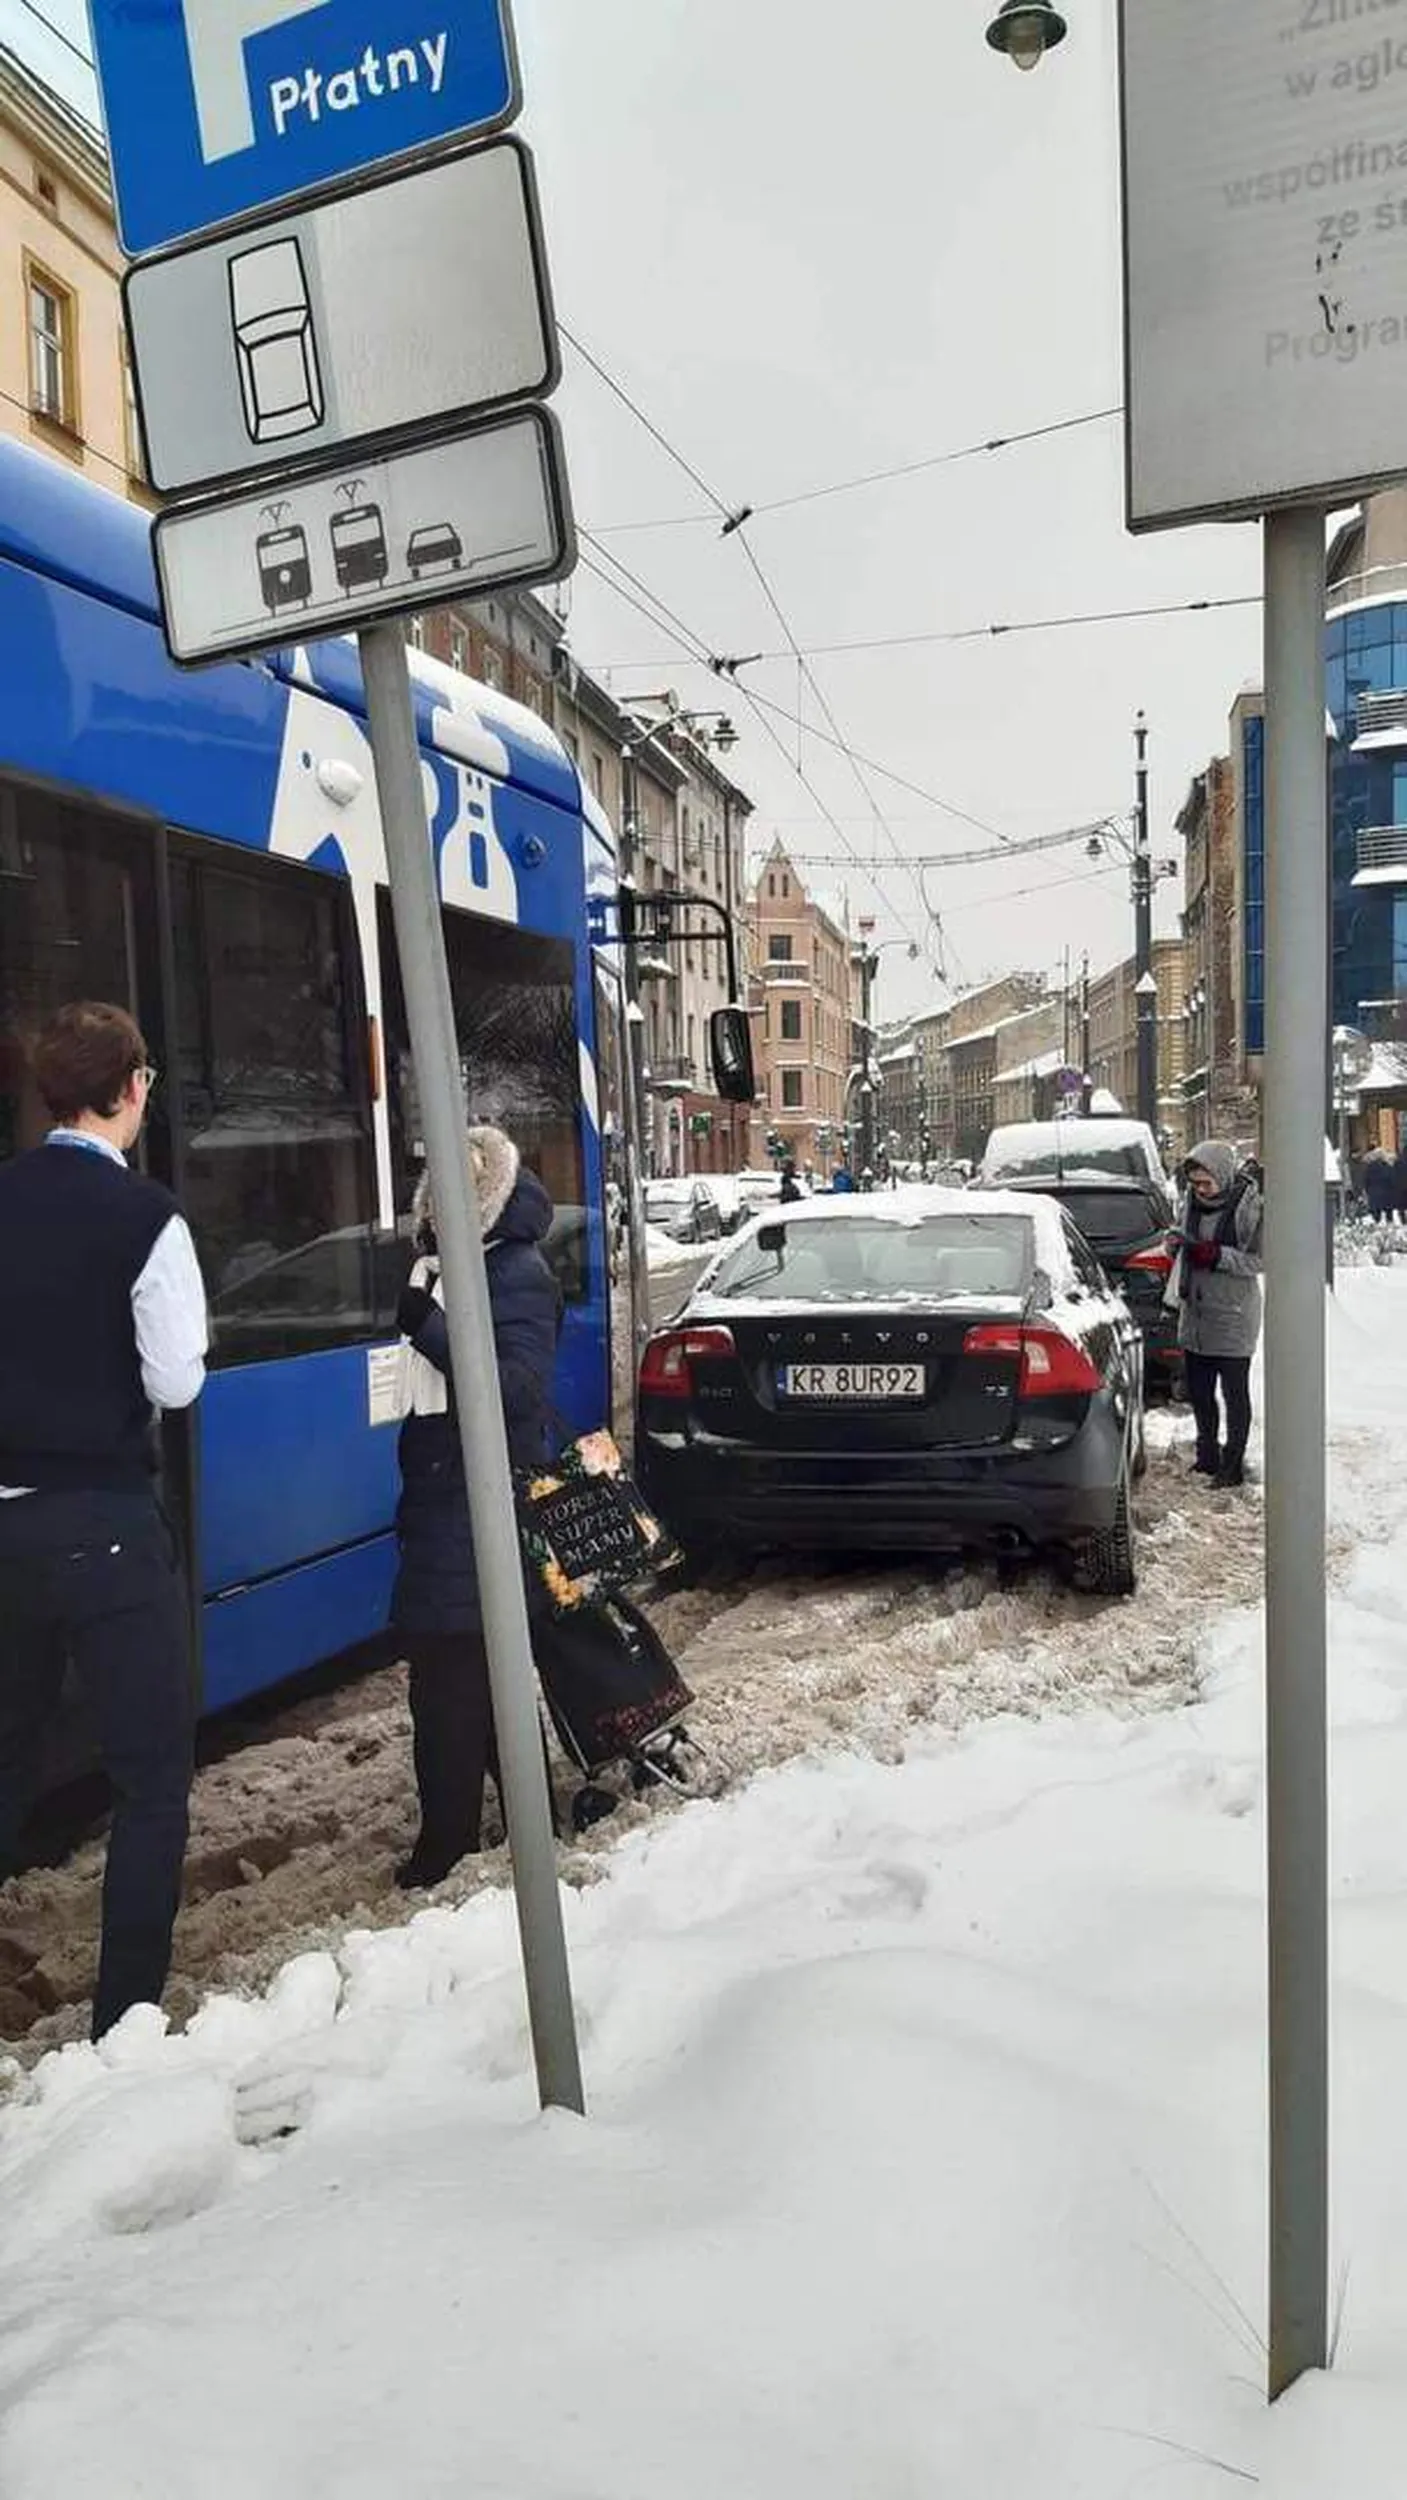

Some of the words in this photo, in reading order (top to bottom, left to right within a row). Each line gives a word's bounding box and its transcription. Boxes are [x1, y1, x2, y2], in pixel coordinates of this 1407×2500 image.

[270, 32, 447, 135] Płatny
[1284, 71, 1317, 98] w
[1316, 212, 1360, 244] ze
[767, 1332, 929, 1343] VOLVO
[791, 1368, 825, 1392] KR
[835, 1367, 917, 1392] 8UR92
[554, 1506, 624, 1541] SUPER
